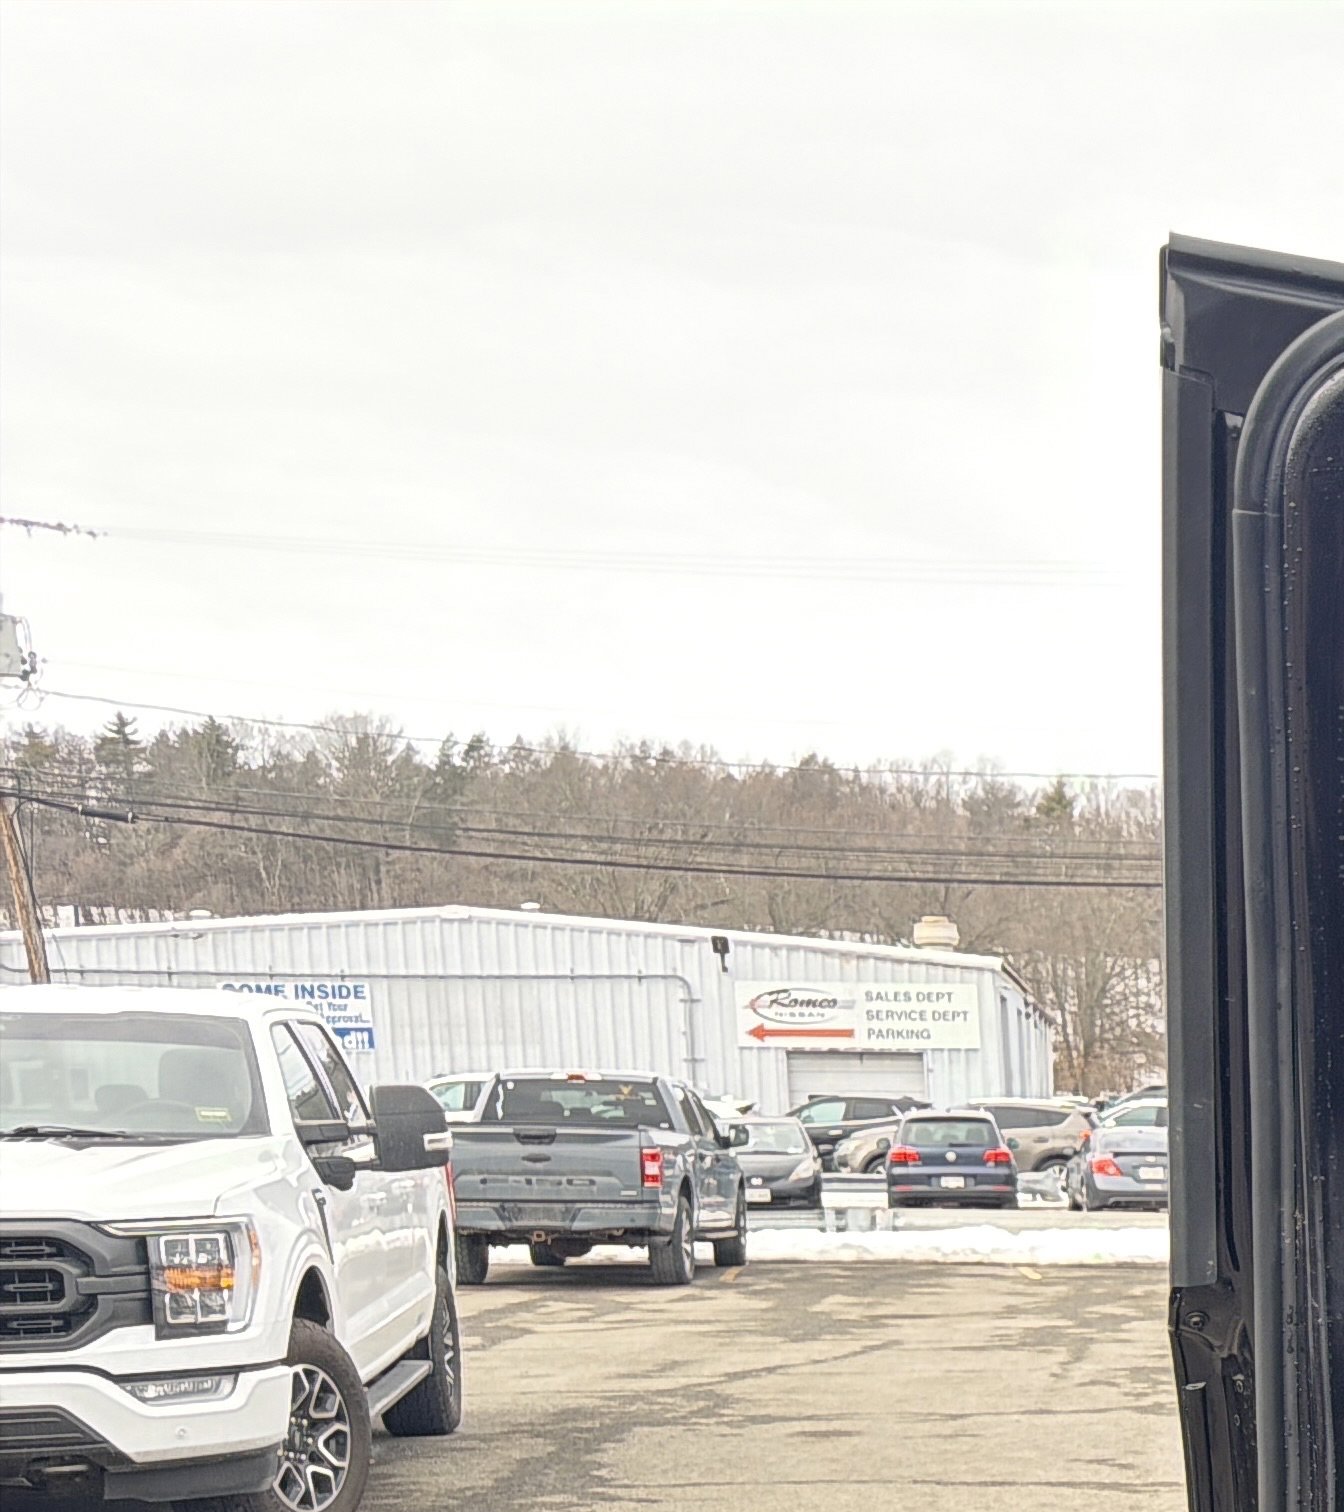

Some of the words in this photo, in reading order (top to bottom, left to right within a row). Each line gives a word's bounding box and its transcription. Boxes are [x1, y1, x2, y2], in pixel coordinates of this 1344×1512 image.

[294, 984, 366, 1000] INSIDE
[865, 991, 912, 1003] SALES
[916, 991, 954, 1004] DEPT
[767, 991, 838, 1009] Romco
[866, 1009, 928, 1022] SERVICE
[932, 1009, 969, 1022] DEPT
[867, 1028, 932, 1041] PARKING
